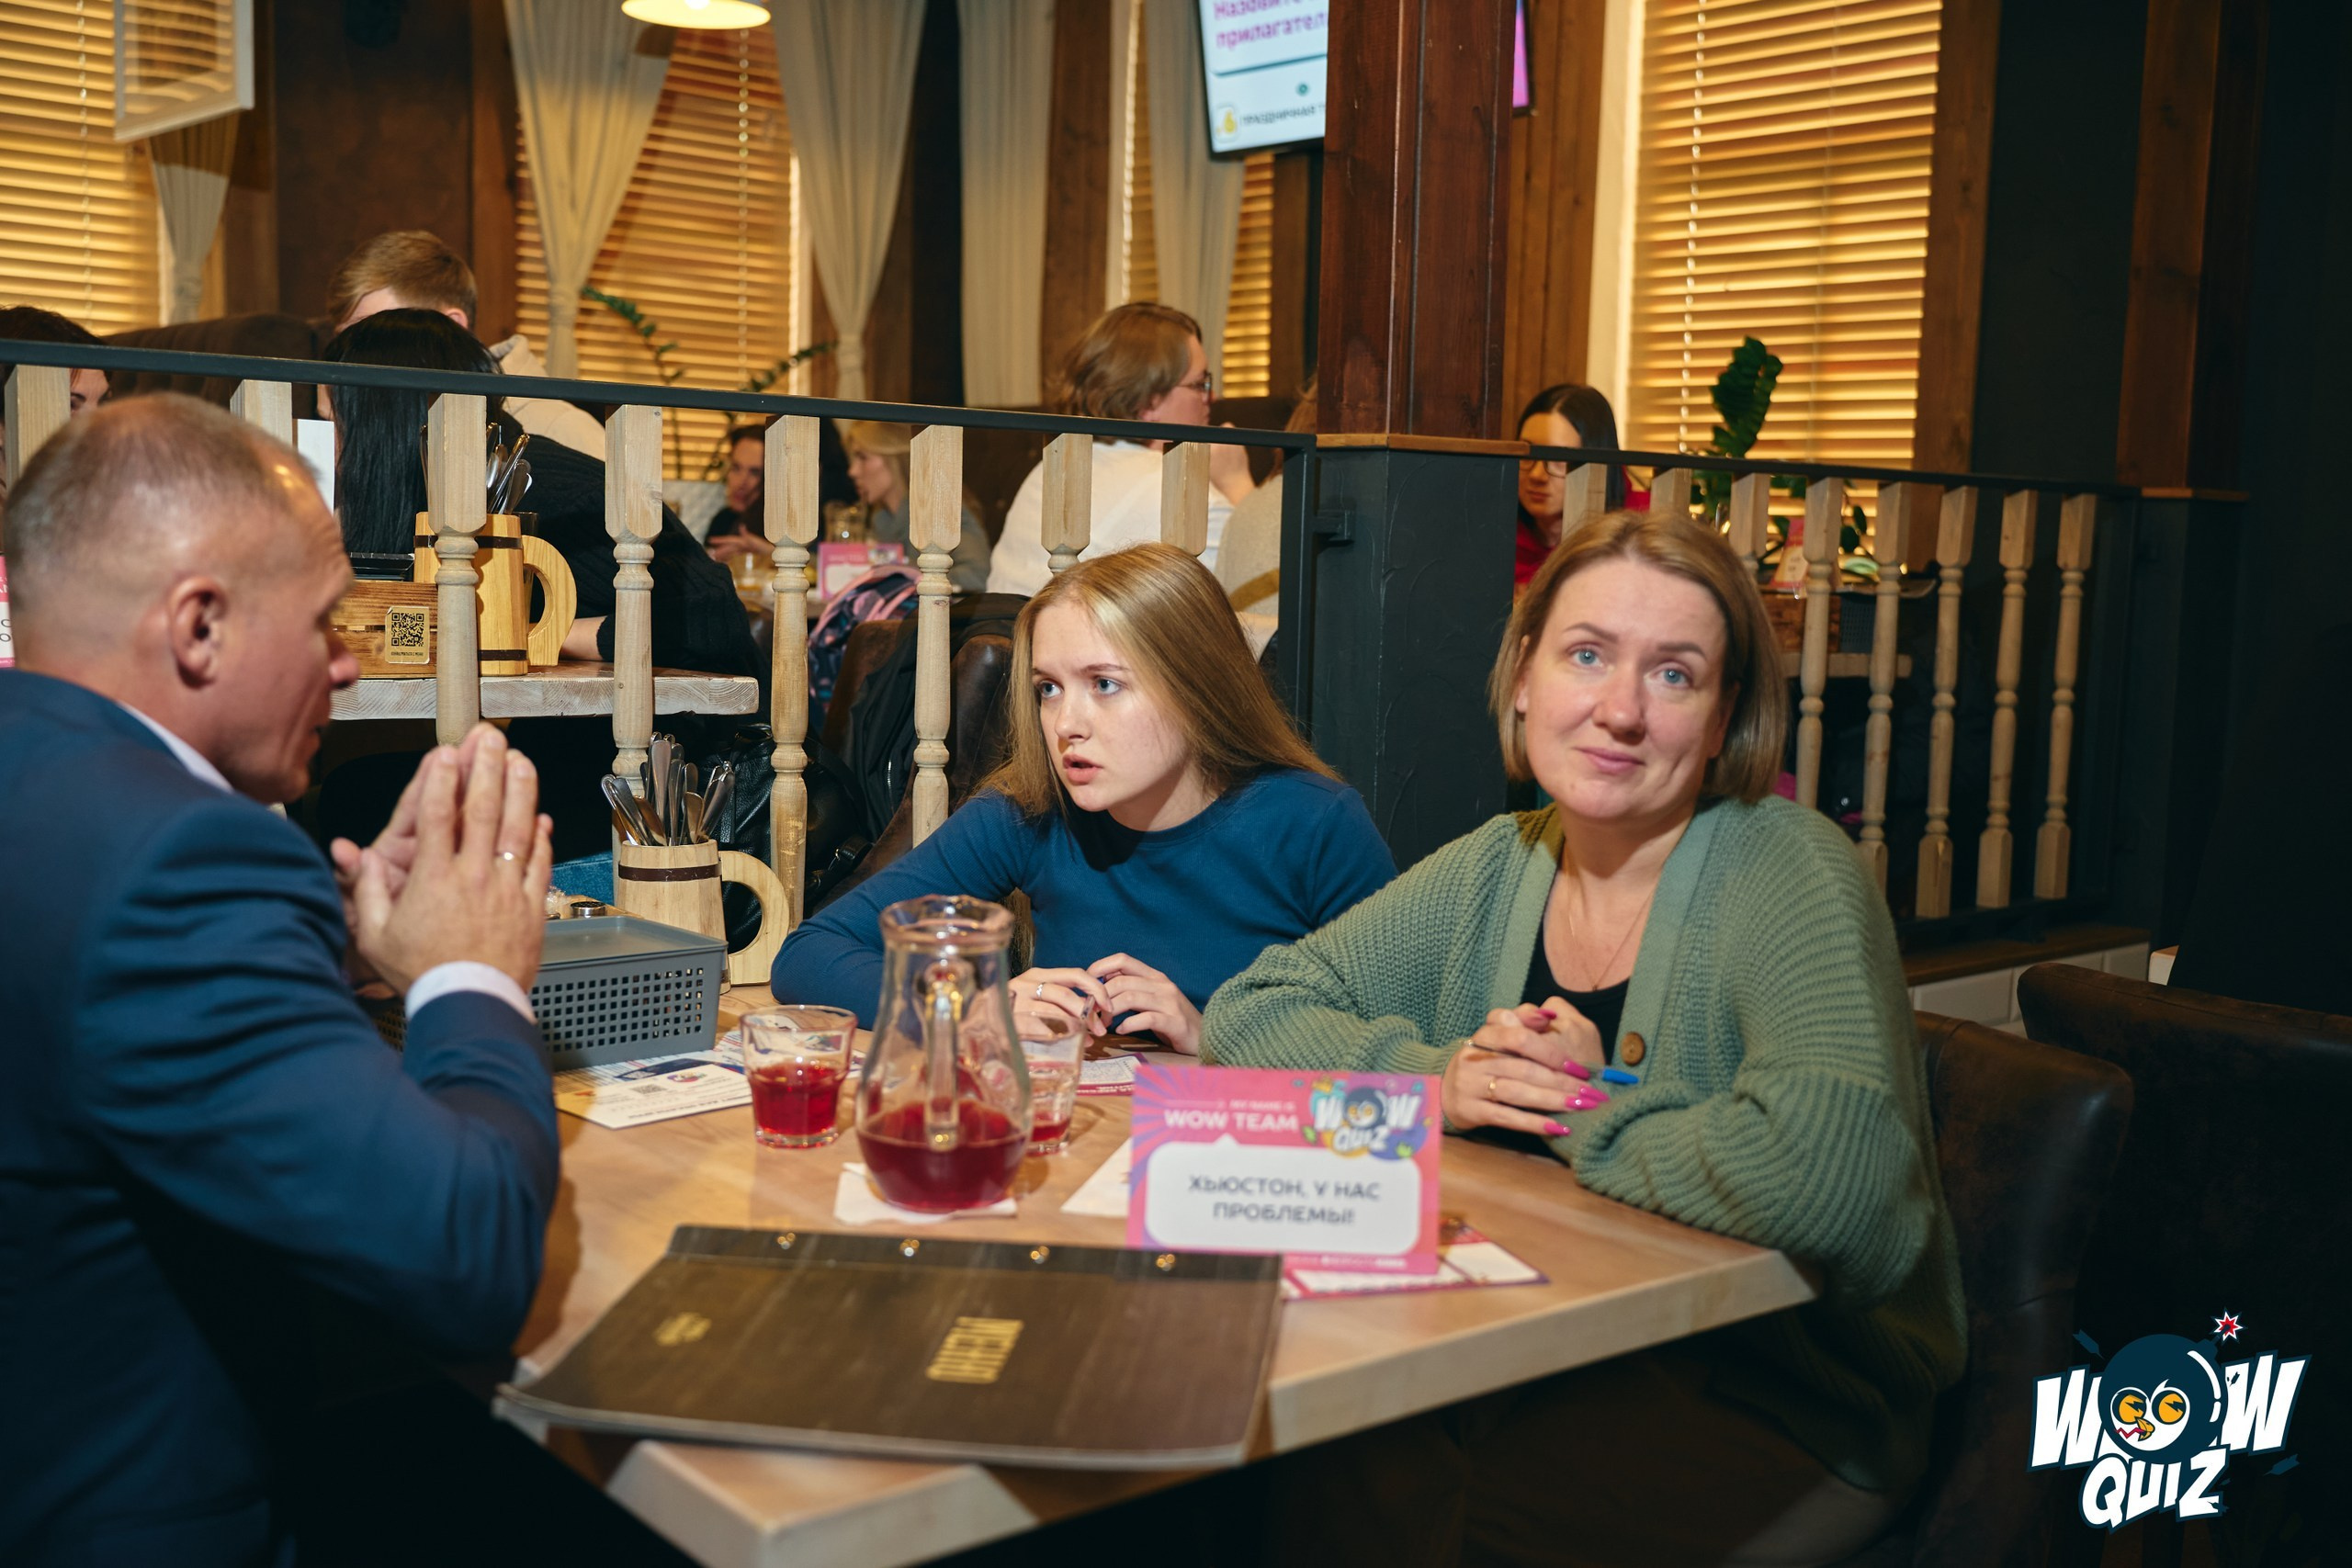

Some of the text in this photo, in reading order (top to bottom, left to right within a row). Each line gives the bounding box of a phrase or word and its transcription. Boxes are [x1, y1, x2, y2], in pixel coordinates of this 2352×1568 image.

[1214, 0, 1301, 20] Назови
[1216, 12, 1328, 51] прилагател
[1164, 1108, 1299, 1133] WOW TEAM
[1332, 1124, 1390, 1154] QUIZ
[1189, 1174, 1382, 1201] ХЬЮСТОН, У НАС
[1213, 1201, 1356, 1226] ПРОБЛЕМЫ!
